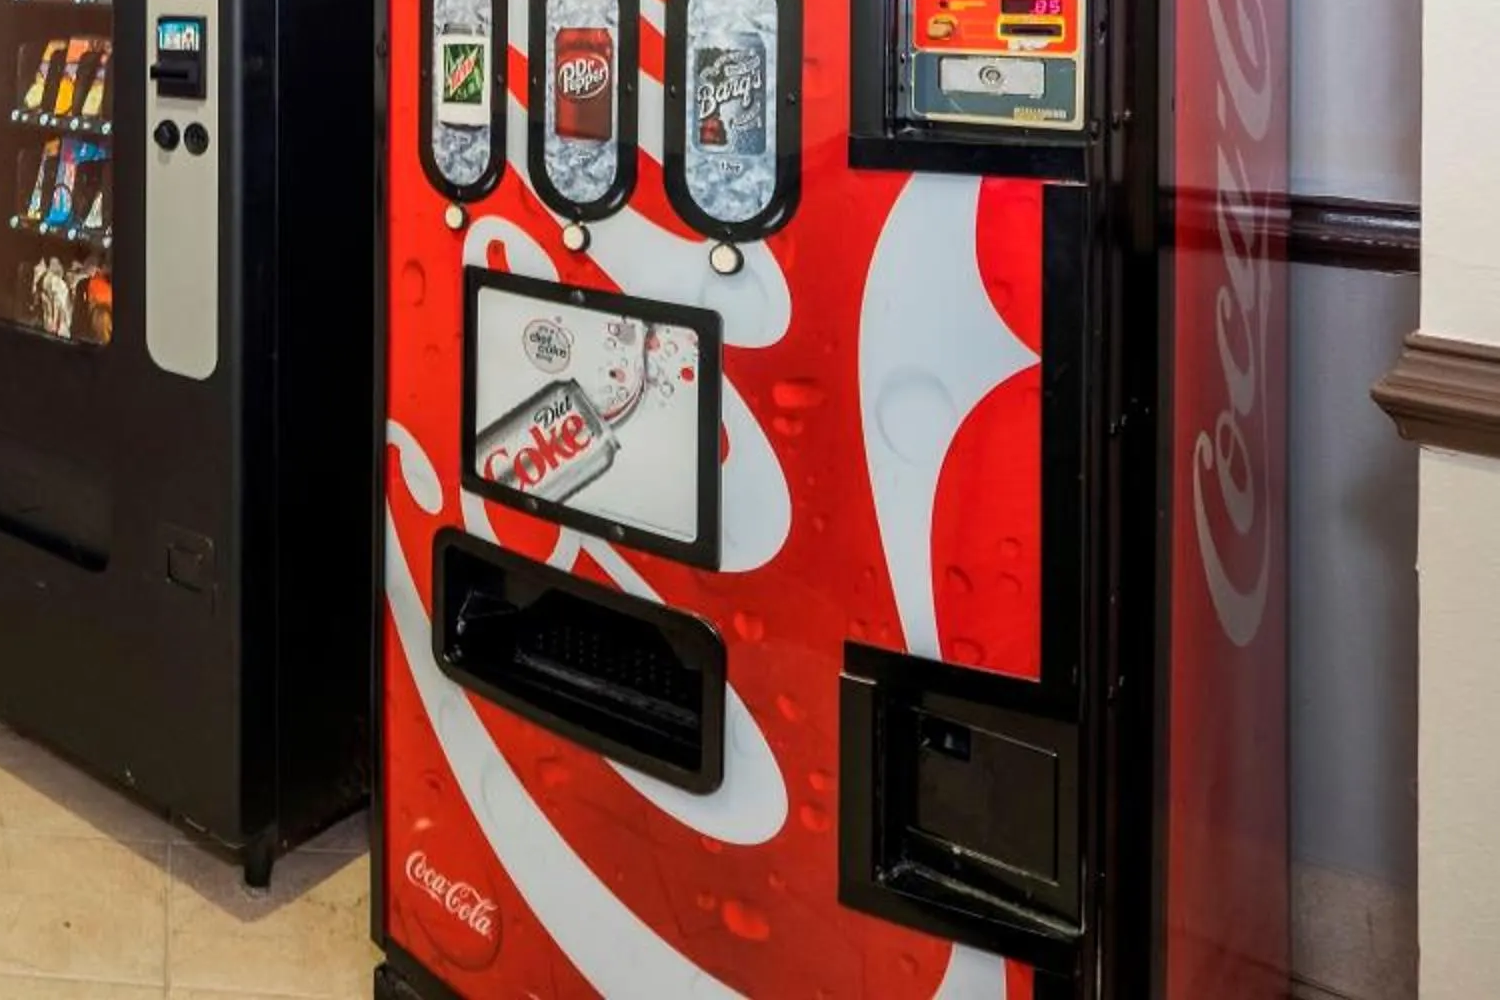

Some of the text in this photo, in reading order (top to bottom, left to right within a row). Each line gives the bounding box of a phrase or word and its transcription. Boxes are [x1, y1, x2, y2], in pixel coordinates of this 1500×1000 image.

[562, 61, 604, 96] Pepper
[575, 57, 596, 77] Dr
[697, 69, 762, 120] Barq's
[533, 395, 573, 430] Diet
[483, 413, 592, 492] Coke
